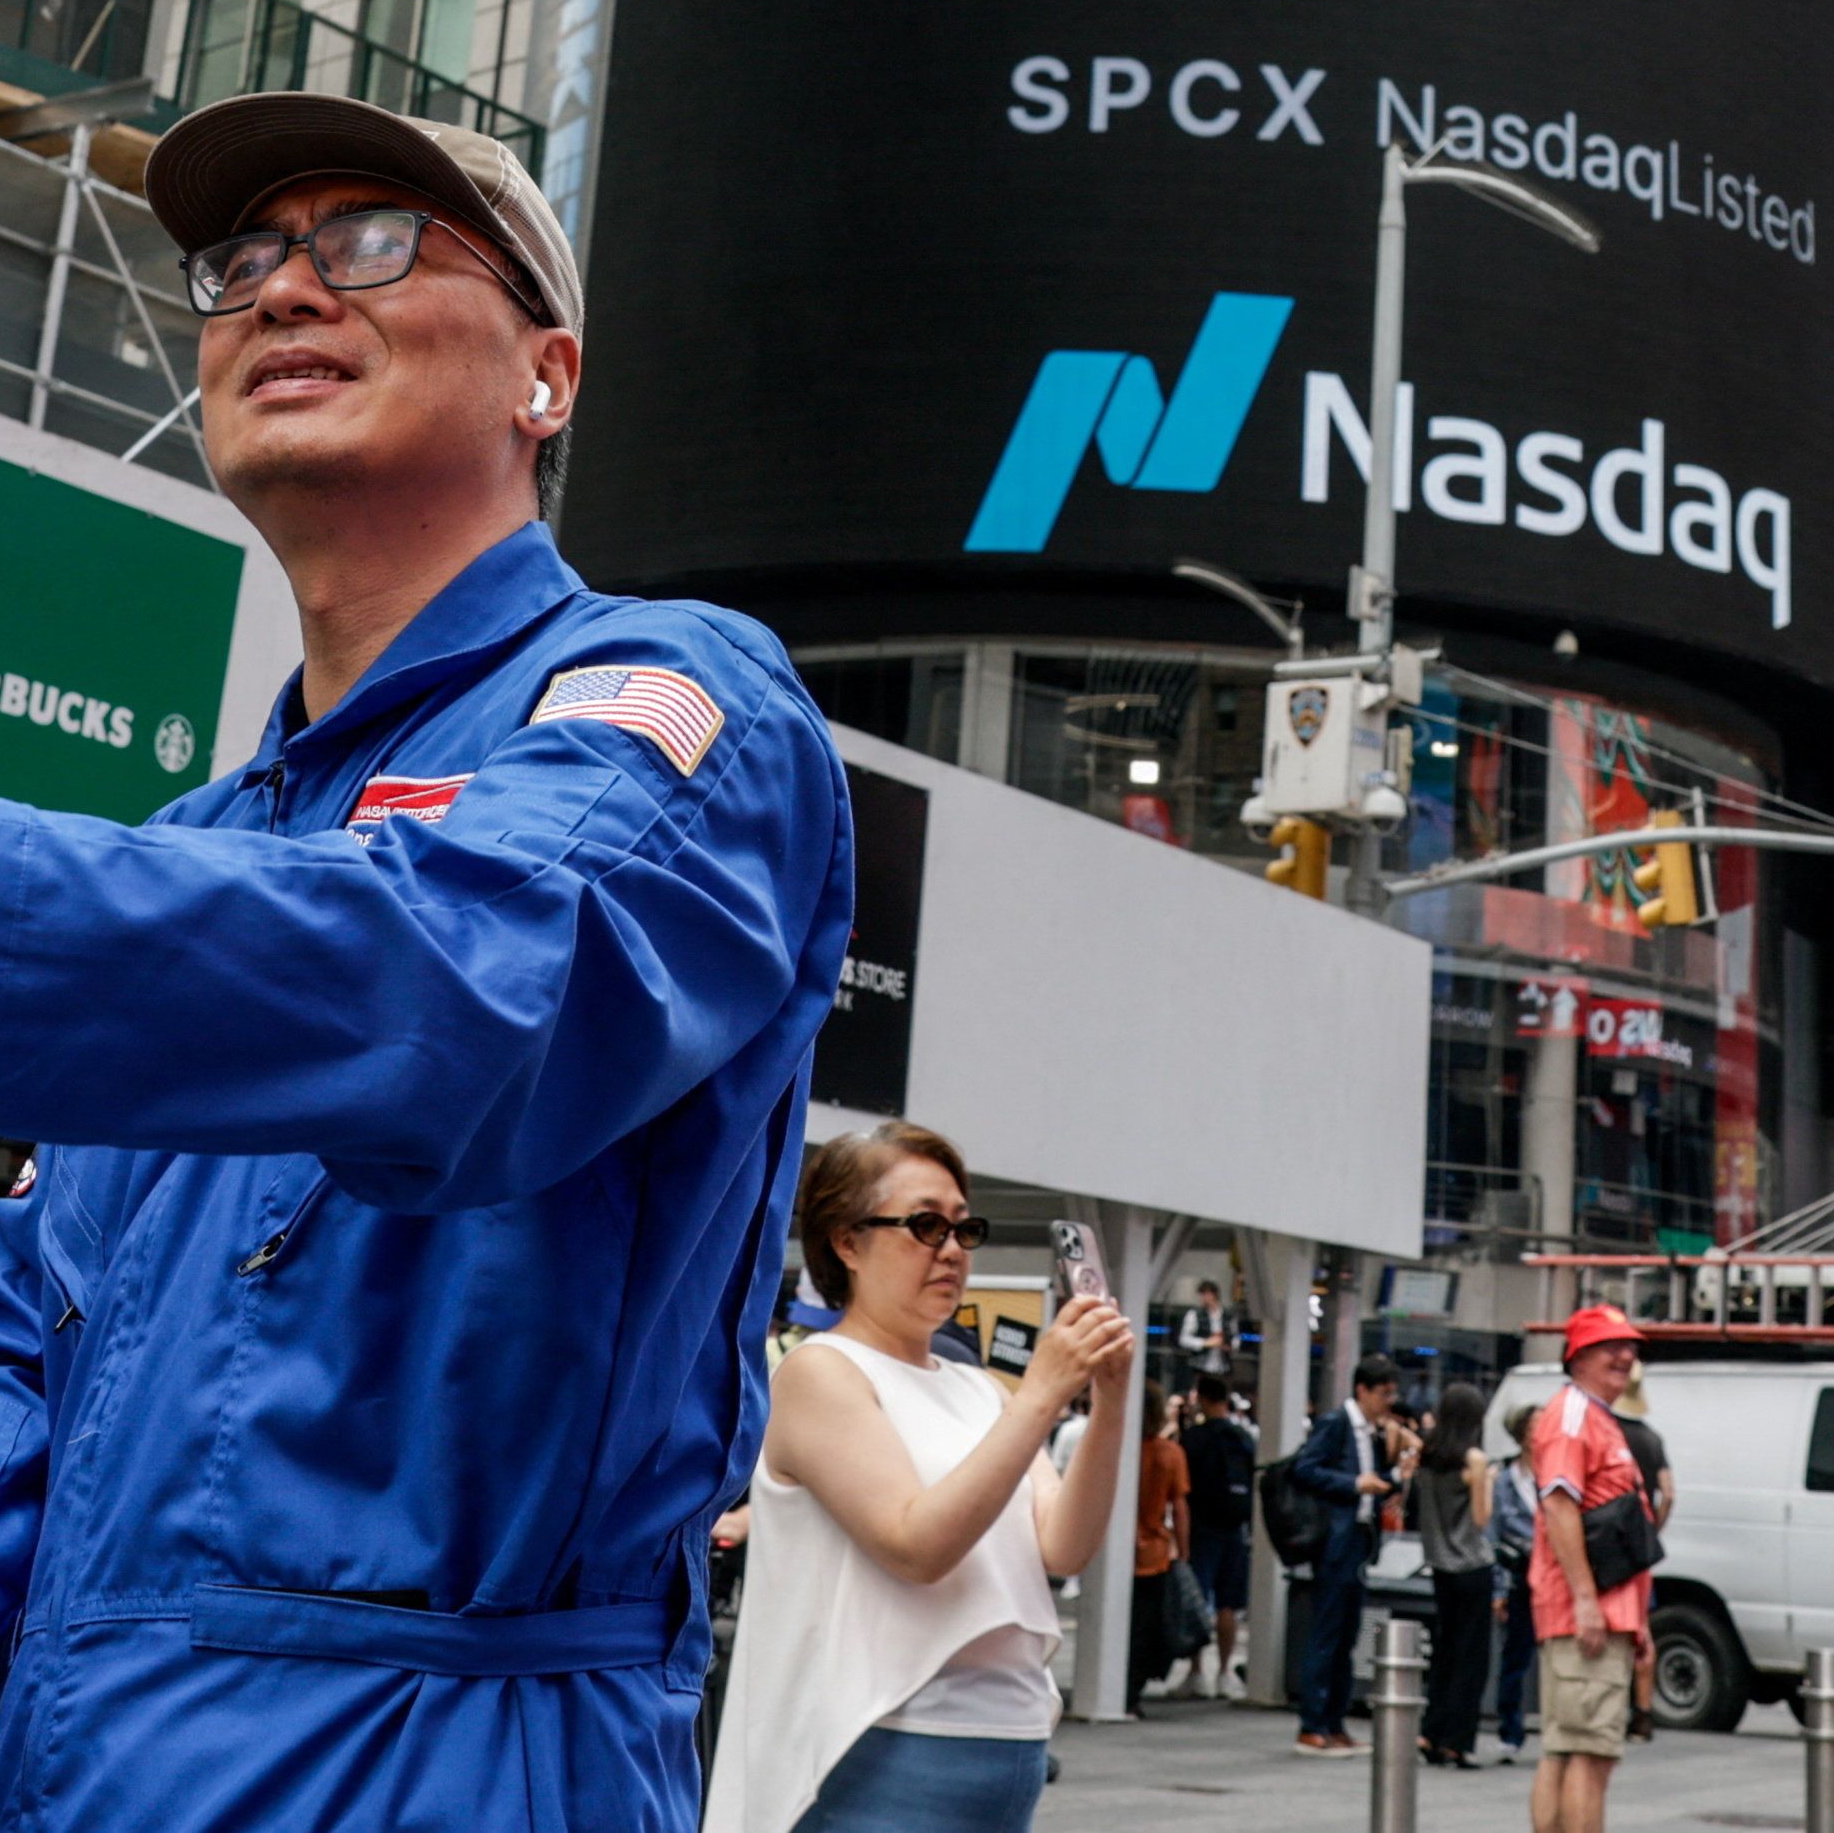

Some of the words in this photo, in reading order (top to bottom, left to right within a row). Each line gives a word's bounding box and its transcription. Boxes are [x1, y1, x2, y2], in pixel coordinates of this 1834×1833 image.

[1007, 55, 1327, 146] SPCX
[1300, 370, 1793, 631] Nasdaq
[855, 959, 907, 1001] STORE
